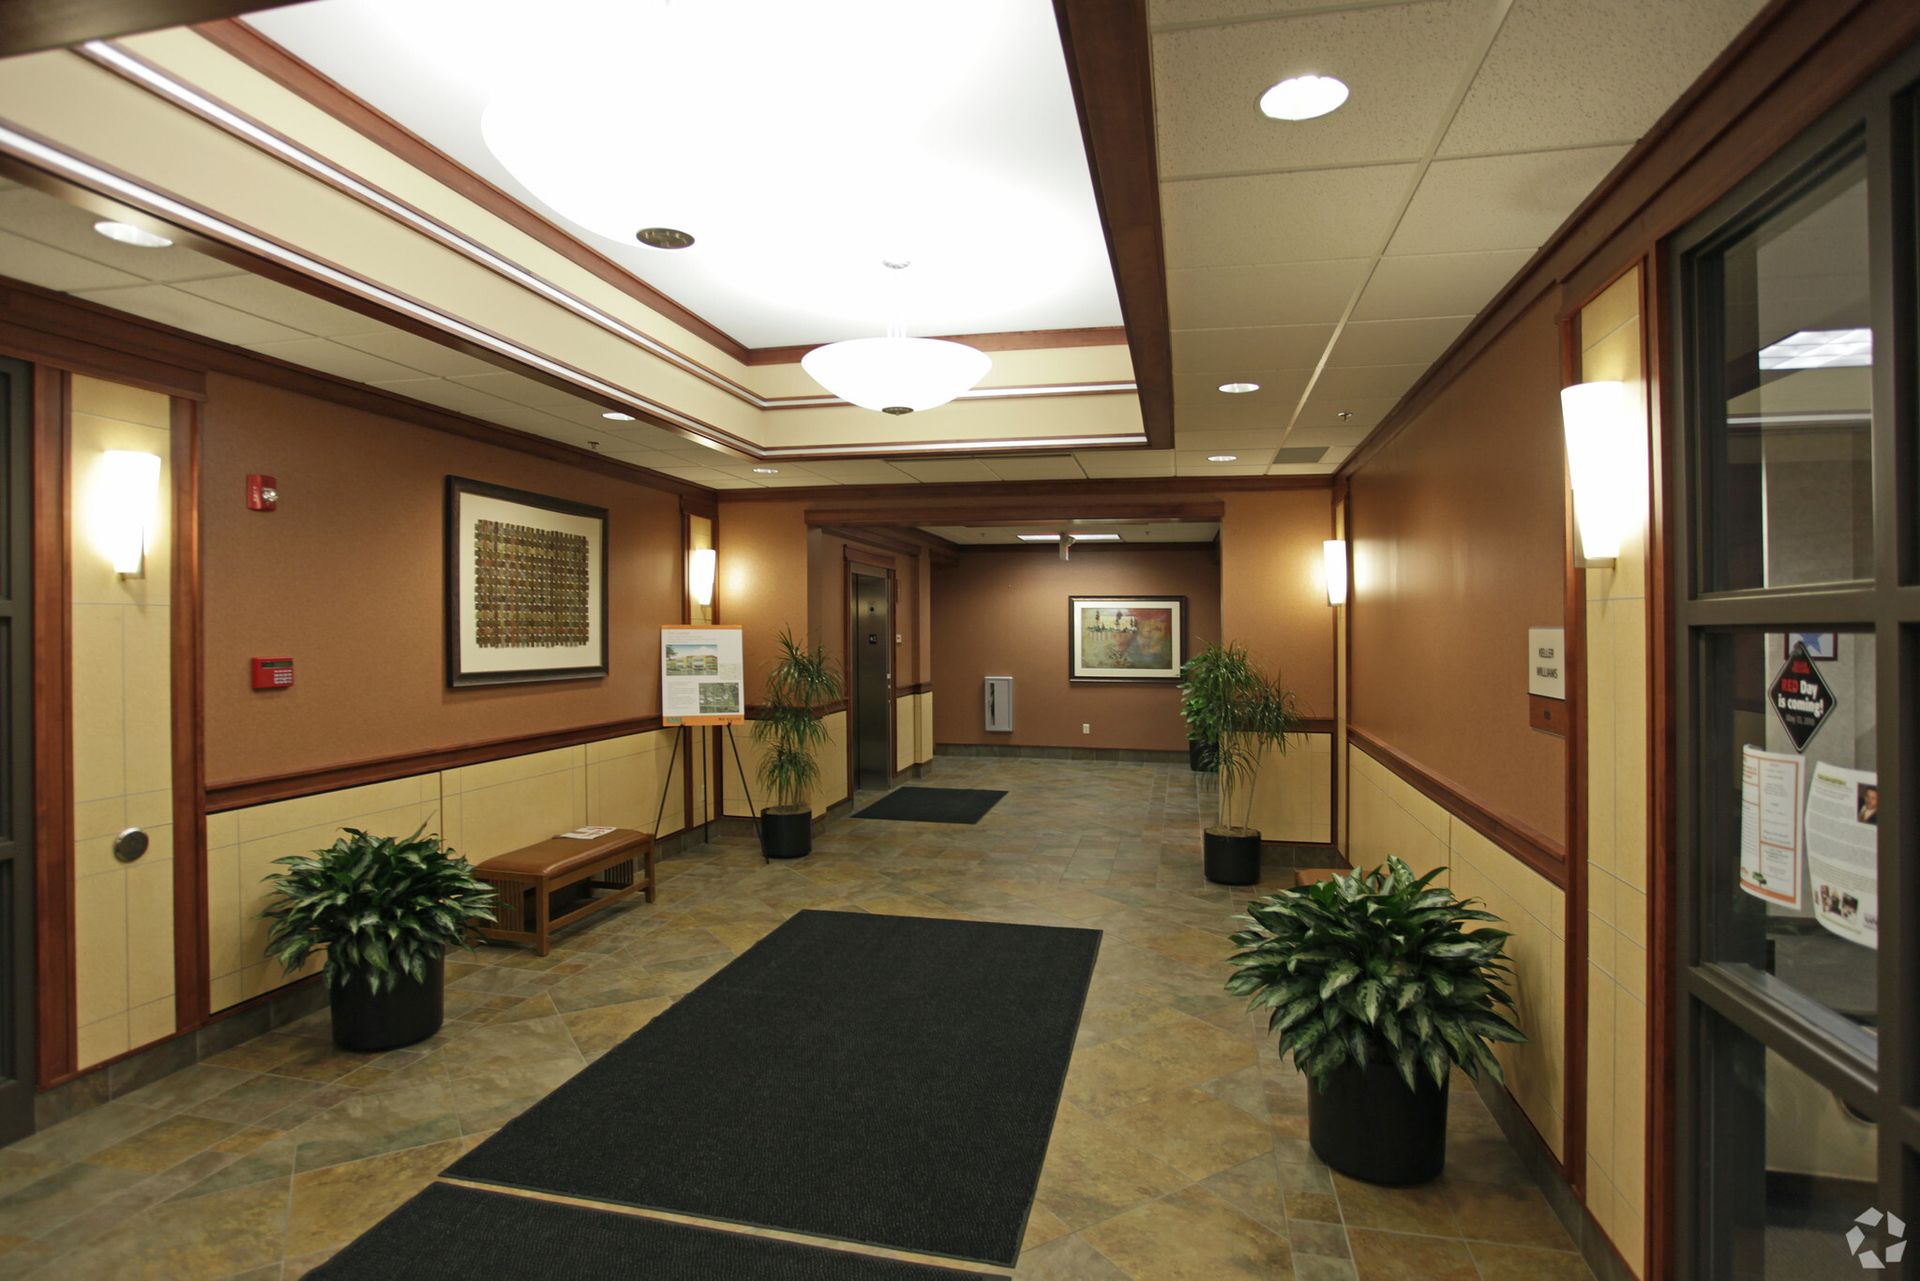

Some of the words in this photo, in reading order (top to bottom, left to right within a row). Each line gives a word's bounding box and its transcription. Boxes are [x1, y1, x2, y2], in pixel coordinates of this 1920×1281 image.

[1538, 647, 1555, 659] KELLER
[1536, 666, 1558, 679] WILLIAMS
[1781, 678, 1799, 693] RED
[1799, 679, 1818, 700] Day
[1778, 693, 1786, 708] is
[1787, 697, 1824, 718] coming!
